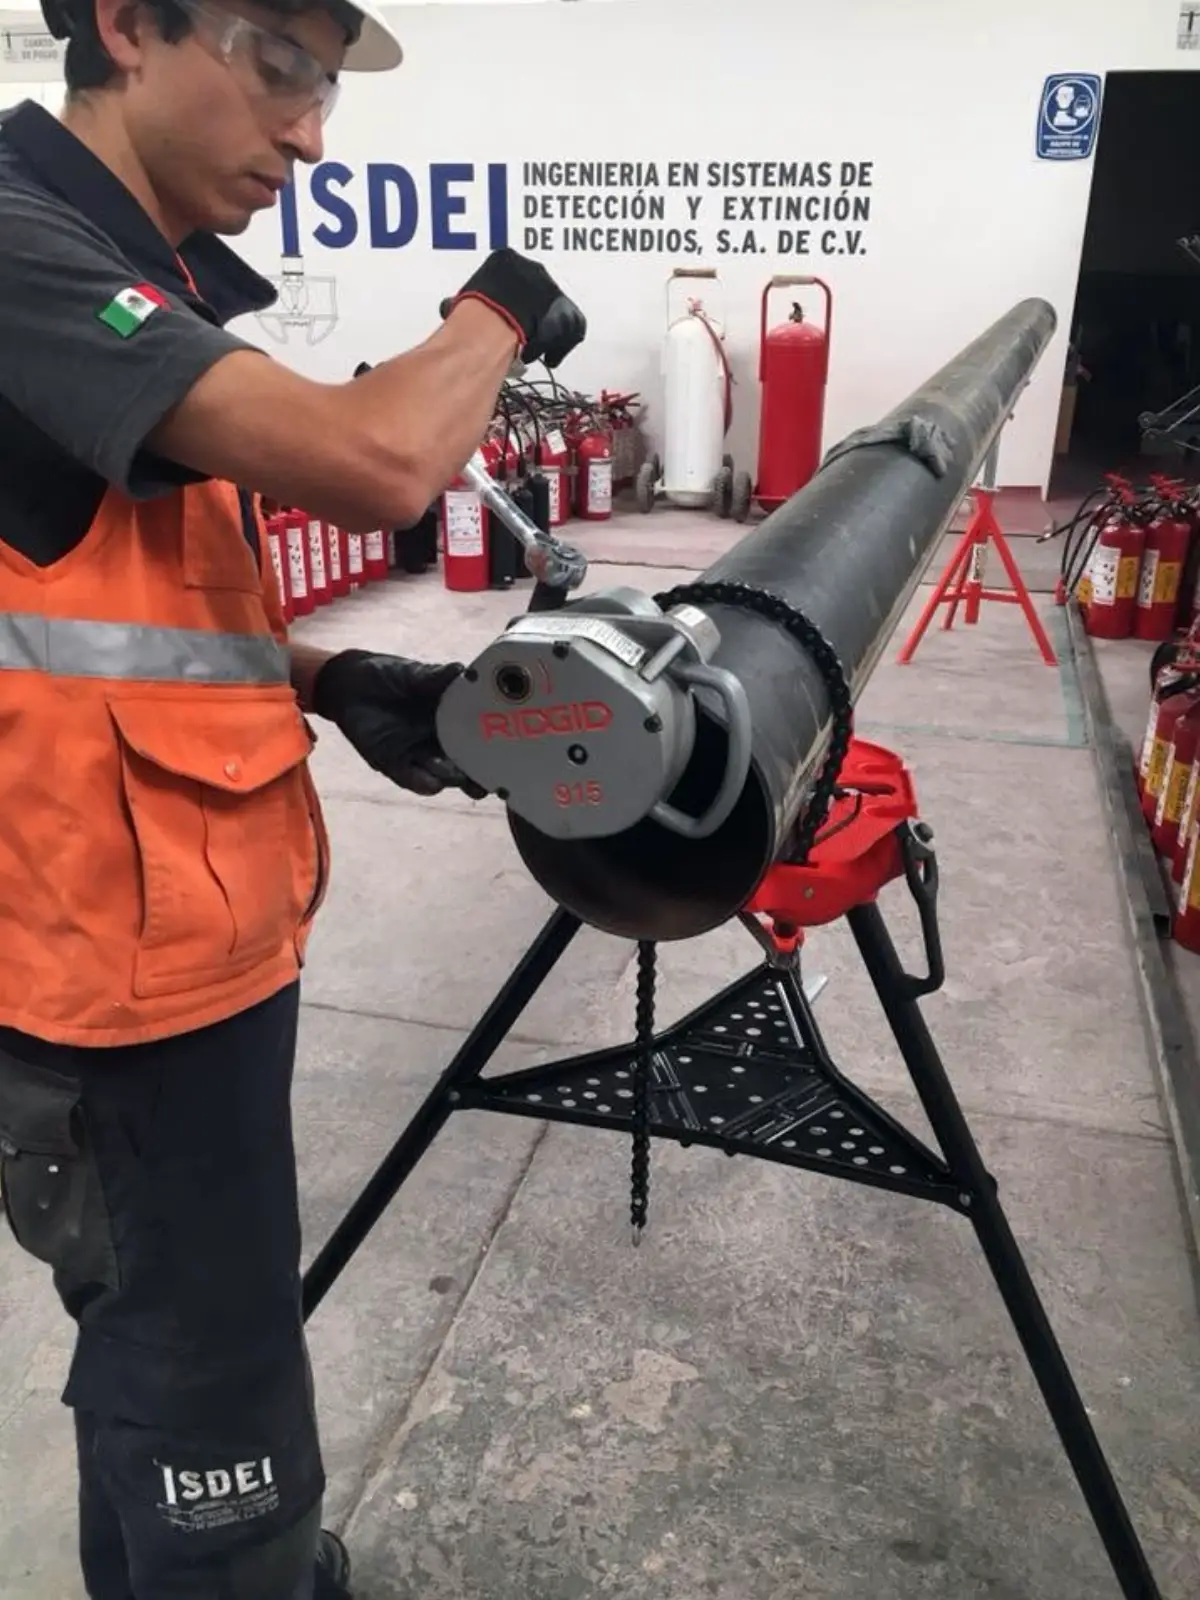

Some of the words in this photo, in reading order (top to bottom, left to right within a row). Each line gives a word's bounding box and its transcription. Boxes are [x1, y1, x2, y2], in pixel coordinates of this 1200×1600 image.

[523, 162, 660, 187] INGENIERIA
[667, 162, 699, 187] EN
[707, 161, 832, 187] SISTEMAS
[840, 161, 873, 187] DE
[278, 160, 509, 257] ISDEI
[523, 189, 665, 220] DETECCIÓN
[686, 196, 702, 221] Y
[723, 189, 871, 222] EXTINCIÓN
[523, 226, 554, 251] DE
[563, 226, 703, 256] INCENDIOS,
[716, 229, 767, 254] S.A.
[777, 229, 811, 255] DE
[820, 229, 867, 256] C.V.
[482, 701, 614, 742] RIDGID
[555, 780, 603, 808] 915
[162, 1456, 274, 1505] ISDEI
